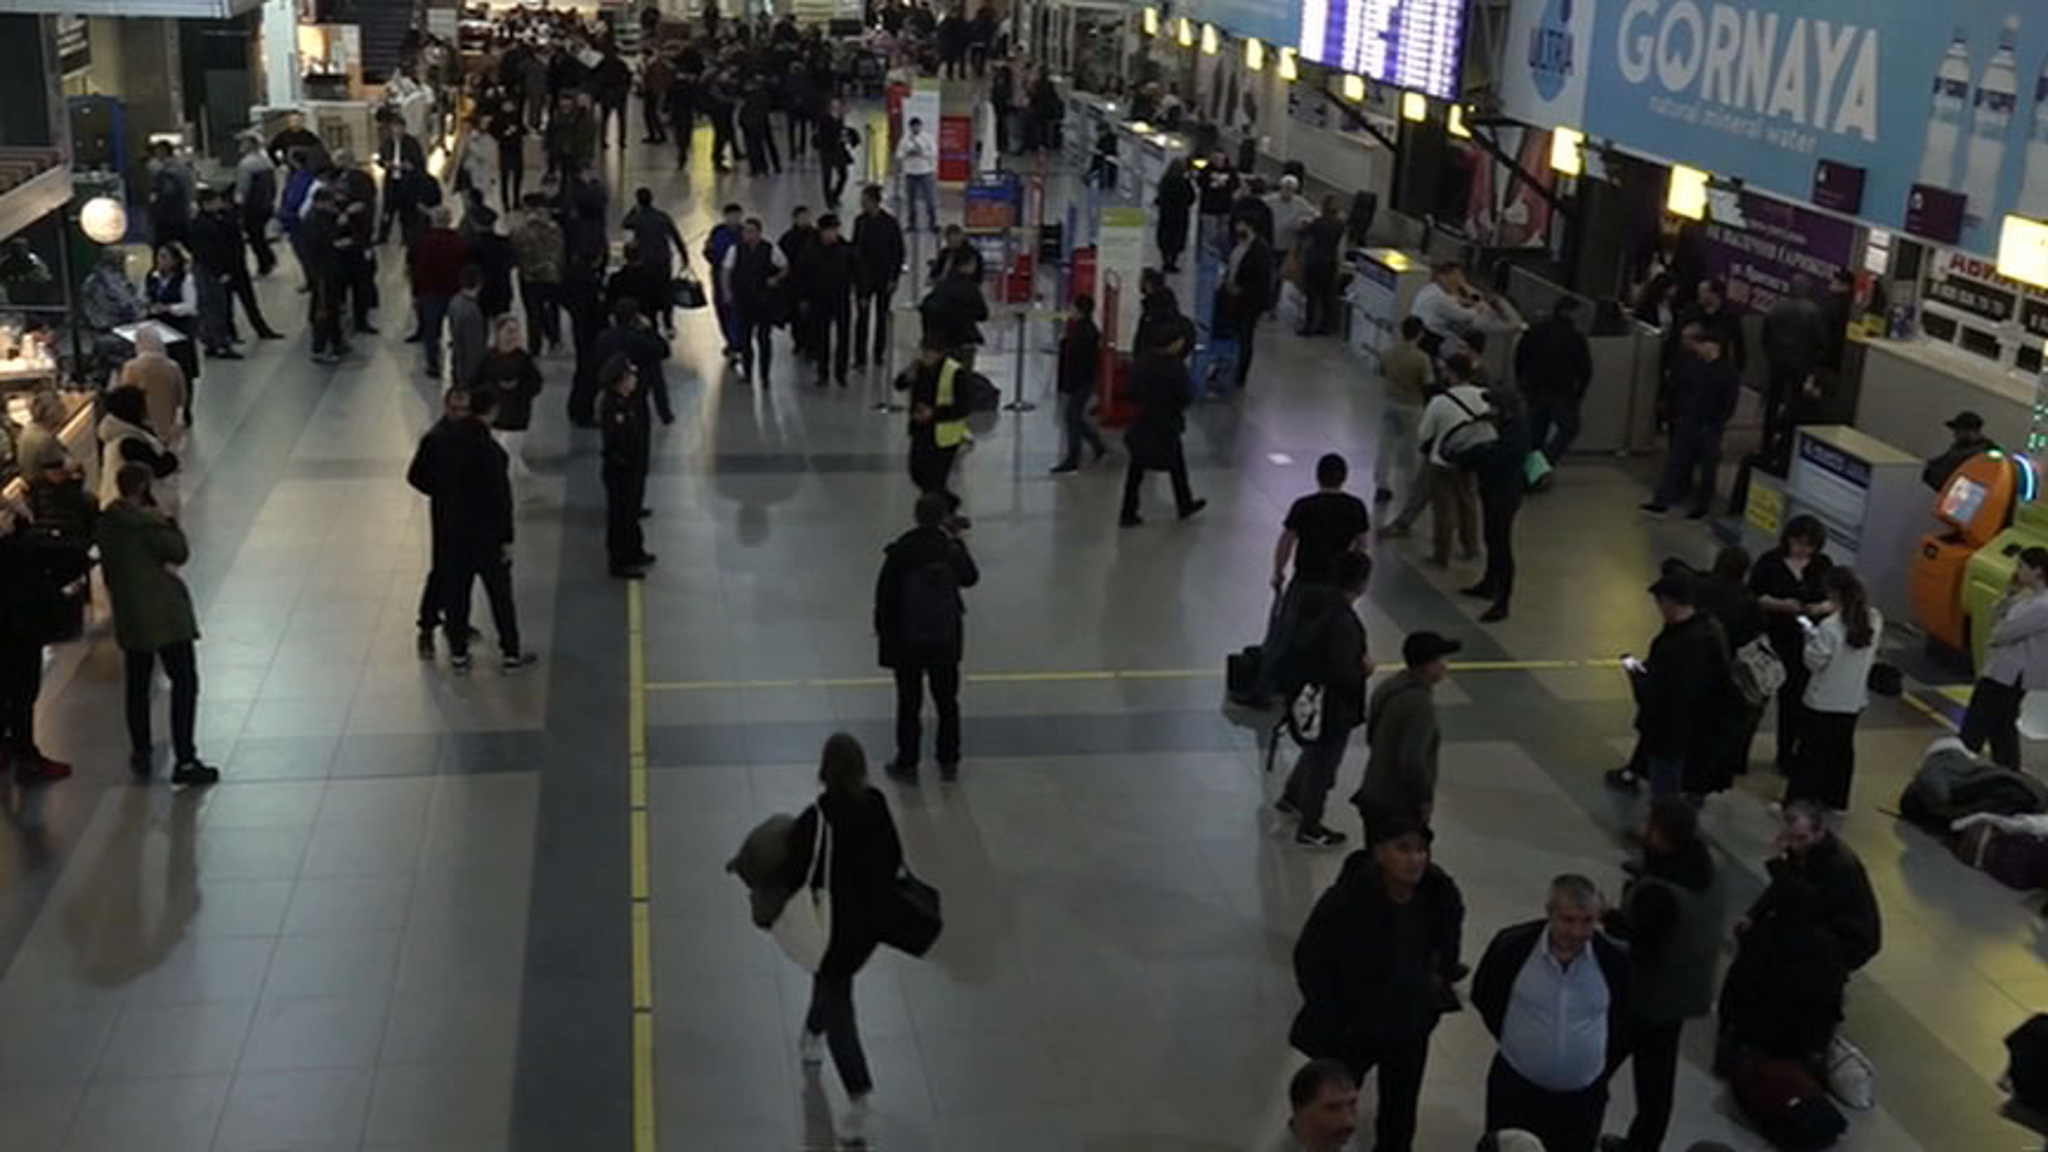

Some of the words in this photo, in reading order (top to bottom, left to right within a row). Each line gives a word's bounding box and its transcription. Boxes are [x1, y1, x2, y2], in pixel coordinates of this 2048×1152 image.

[1618, 0, 1877, 142] GORNAYA
[1648, 94, 1700, 124] natural
[1700, 108, 1763, 139] mineral
[1764, 124, 1817, 153] water
